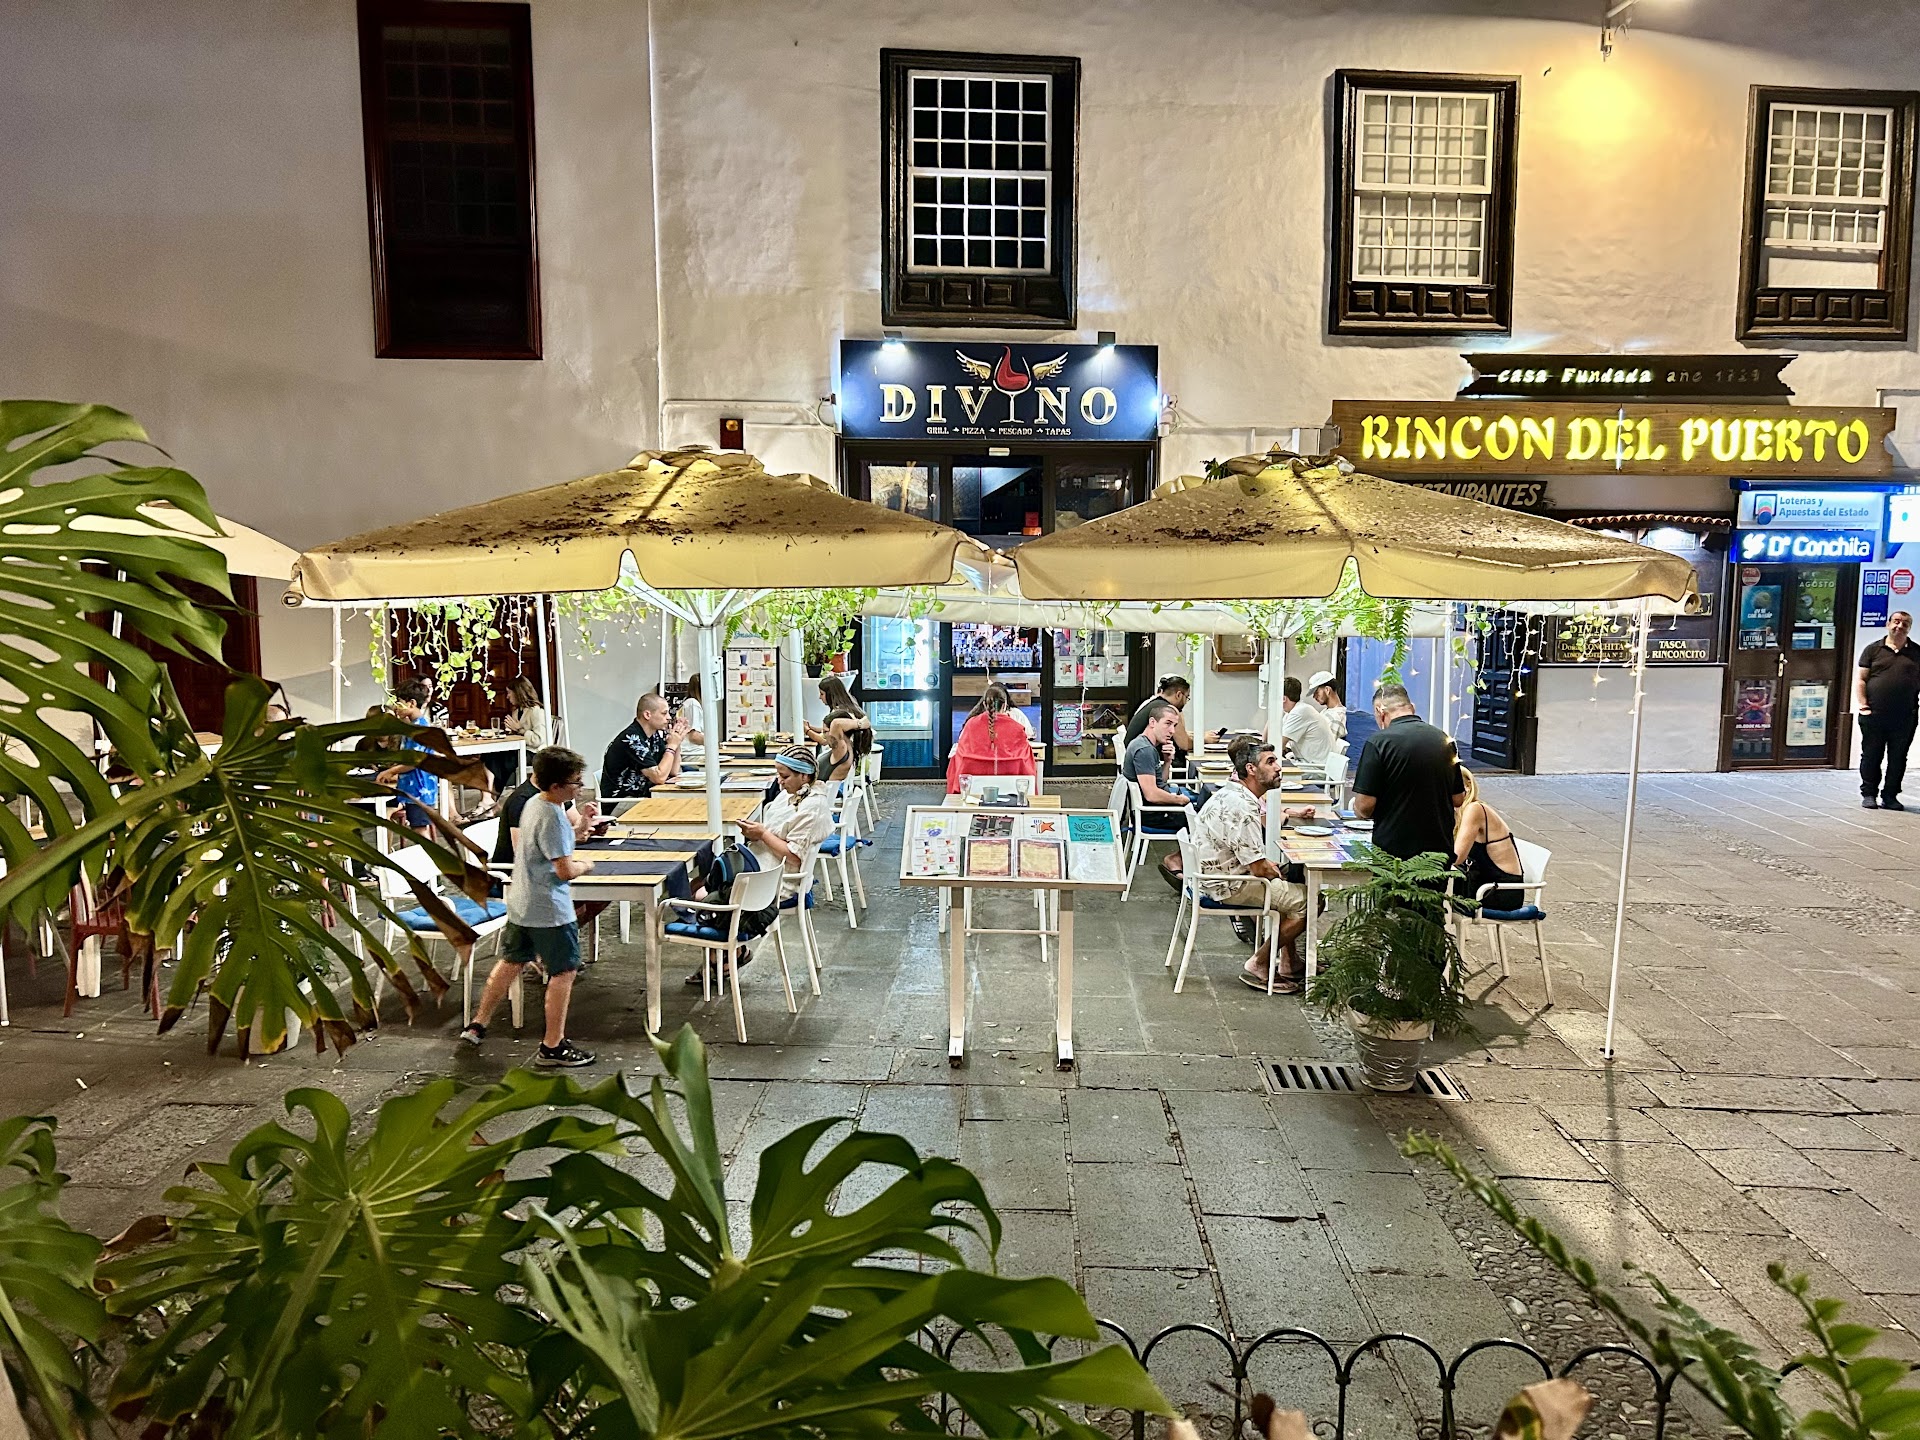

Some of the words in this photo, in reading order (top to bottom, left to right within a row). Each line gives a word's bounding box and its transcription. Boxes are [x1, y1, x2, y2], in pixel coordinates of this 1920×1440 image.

[1561, 367, 1653, 383] Fundada
[879, 382, 1118, 425] DIVINO
[926, 426, 950, 435] GRILL
[962, 427, 985, 435] PIZZA
[998, 427, 1033, 436] PESCADO
[1045, 427, 1072, 436] TAPAS
[1361, 414, 1555, 460] RINCON
[1567, 416, 1668, 462] DEL
[1681, 416, 1870, 465] PUERTO
[1403, 482, 1542, 507] TAURANTES
[1818, 498, 1824, 507] y
[1779, 507, 1821, 518] Apuestas
[1823, 507, 1836, 517] del
[1839, 507, 1869, 517] Estado
[1792, 535, 1870, 557] Conchita
[1659, 640, 1687, 649] TASCA
[1652, 650, 1706, 659] RINCONCITO
